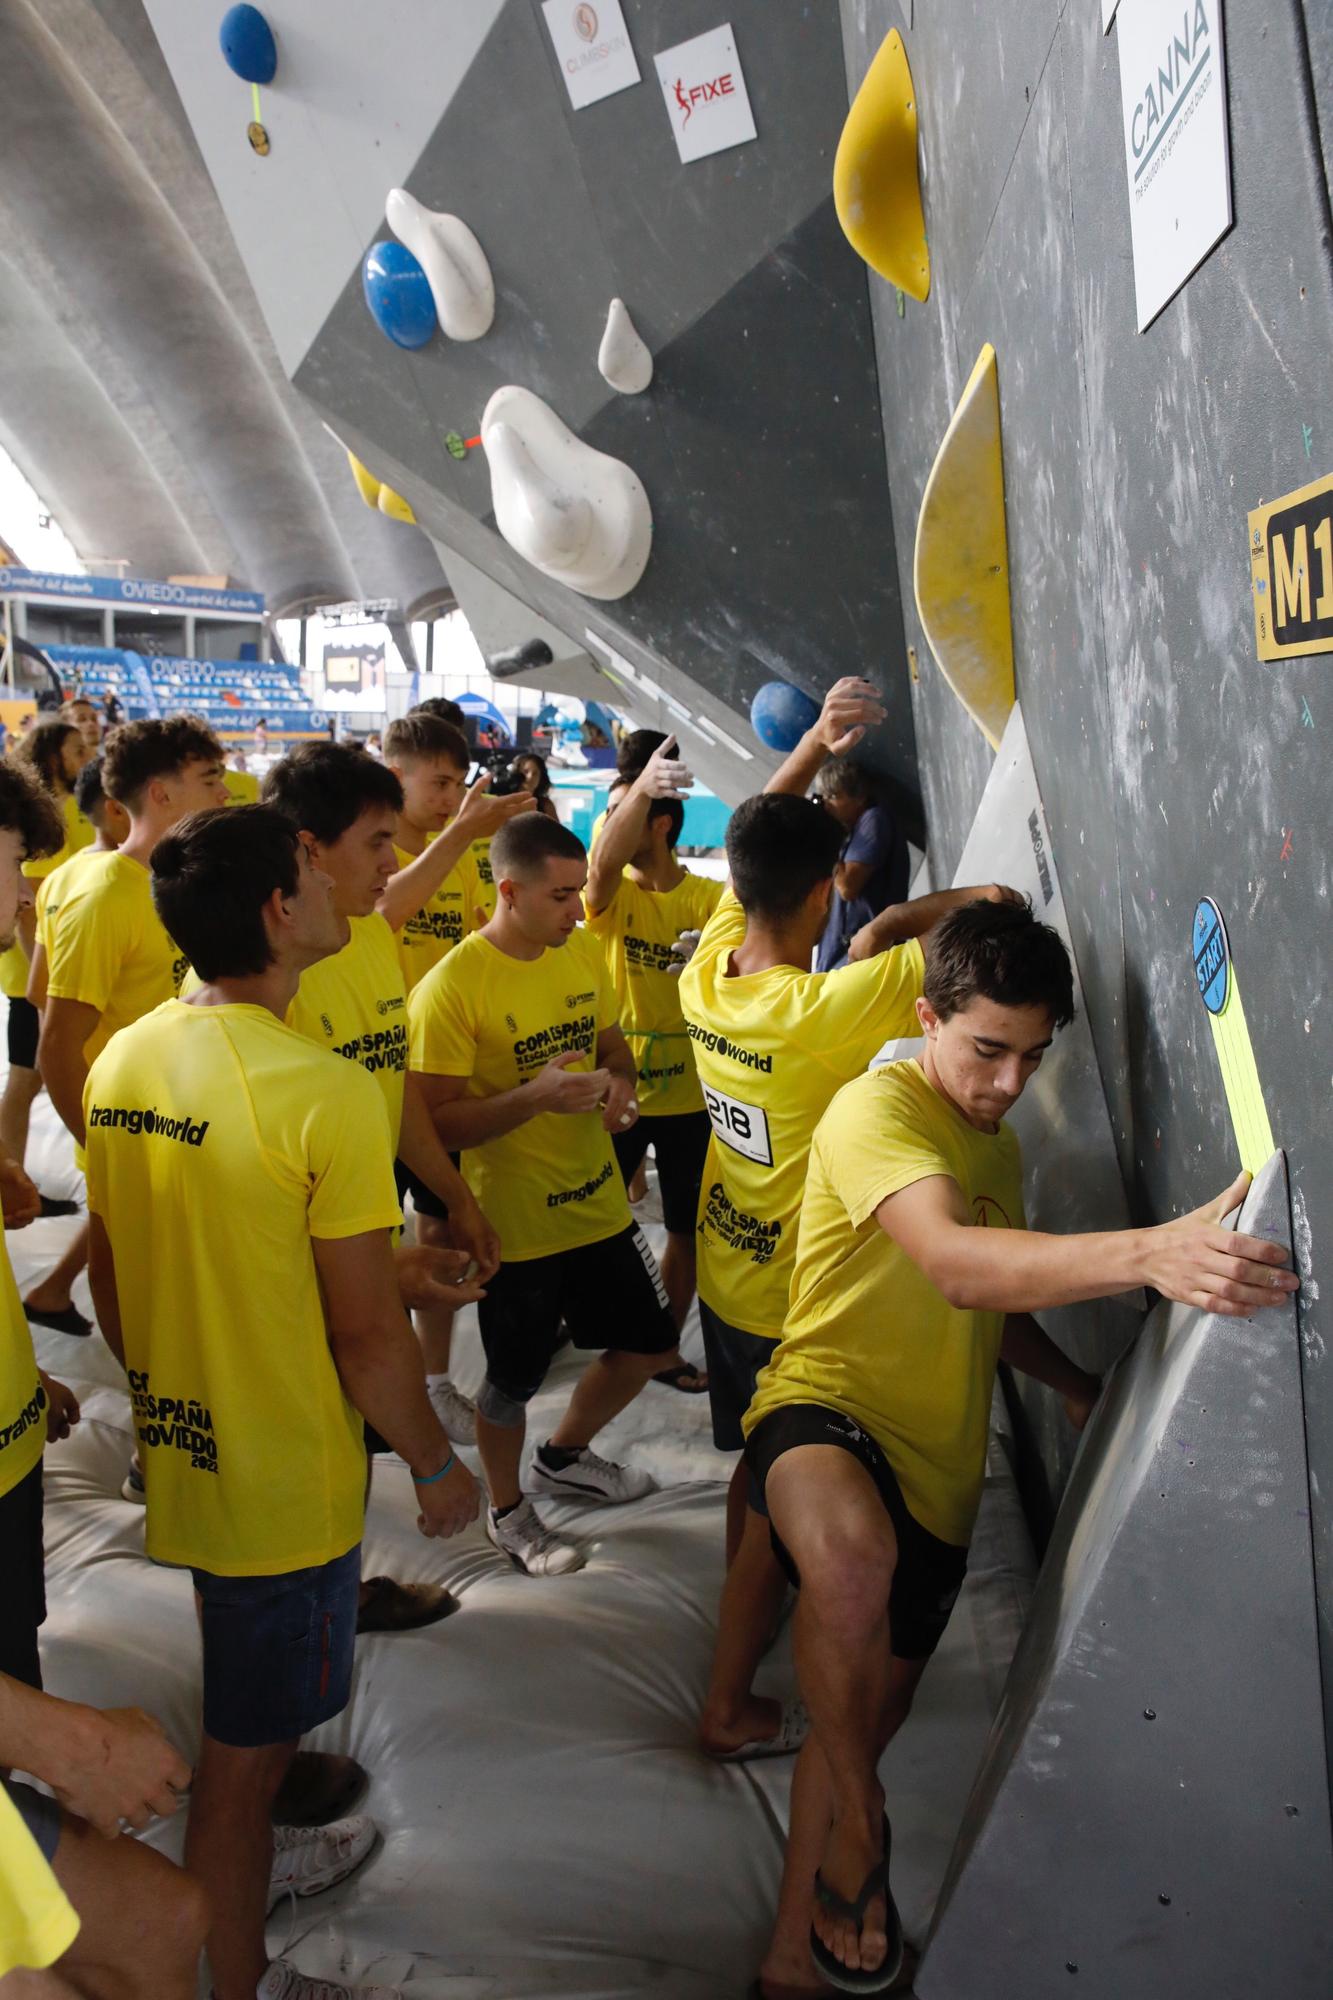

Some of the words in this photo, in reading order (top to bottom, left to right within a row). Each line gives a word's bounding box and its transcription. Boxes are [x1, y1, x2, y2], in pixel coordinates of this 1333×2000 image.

[689, 74, 735, 107] FIXE
[1131, 0, 1211, 158] CANNA
[121, 579, 186, 603] OVIEDO
[151, 658, 216, 678] OVIEDO
[1196, 926, 1224, 993] START
[514, 1029, 553, 1056] COPA
[549, 1015, 595, 1042] ESPAÑA
[90, 1103, 209, 1148] trangoworld
[705, 1090, 751, 1139] 218
[146, 1423, 218, 1460] OVIEDO
